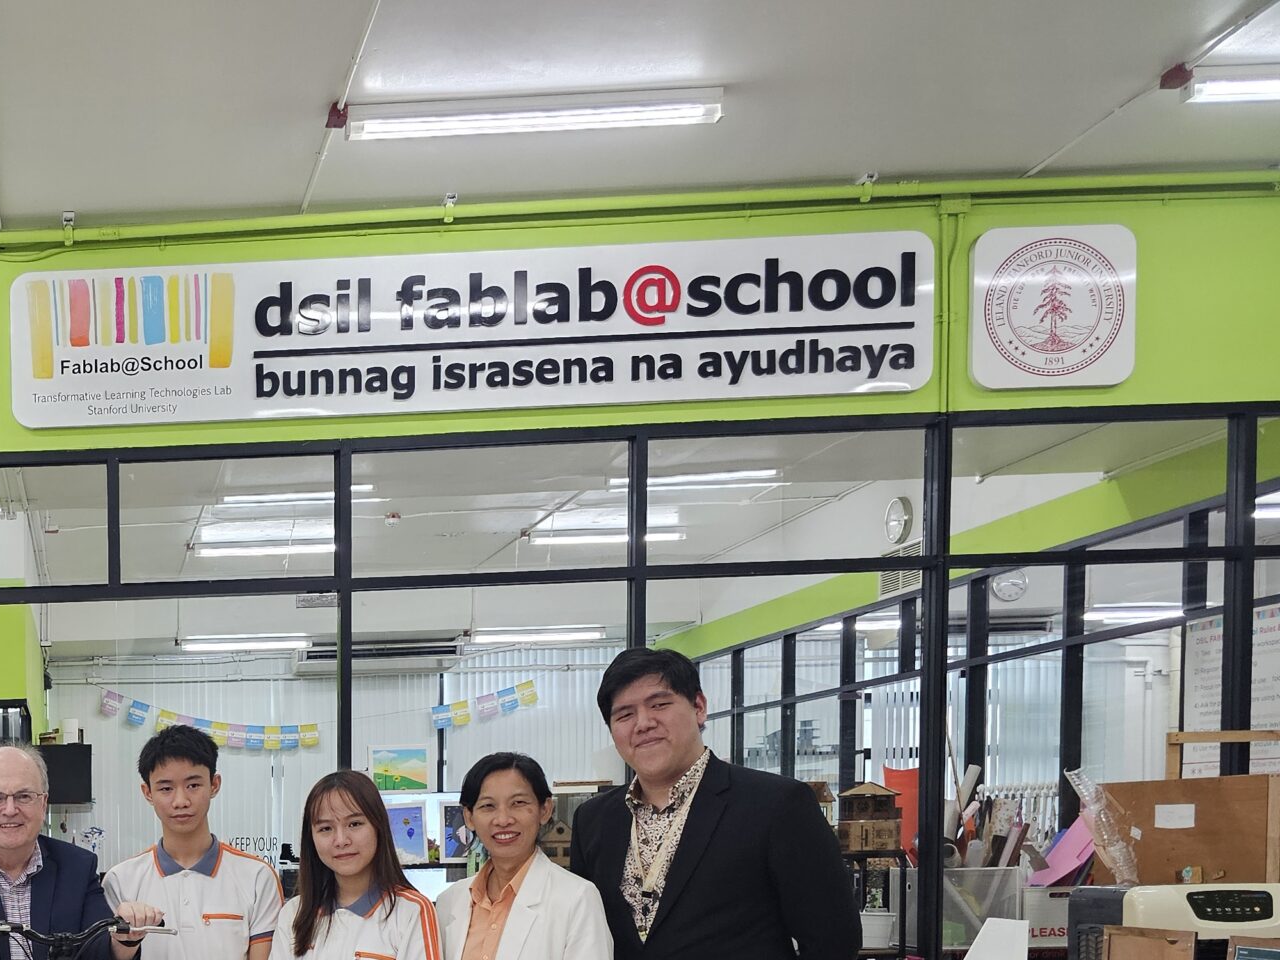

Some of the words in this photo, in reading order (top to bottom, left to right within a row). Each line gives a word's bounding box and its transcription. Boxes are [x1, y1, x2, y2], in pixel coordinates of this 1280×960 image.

[1005, 248, 1053, 281] TANFORD
[1054, 248, 1092, 268] JUNIOR
[254, 277, 371, 337] dsil
[395, 251, 916, 331] fablab@school
[60, 354, 203, 376] Fablab@School
[255, 363, 416, 400] bunnag
[432, 354, 614, 391] israsena
[630, 354, 683, 382] na
[697, 338, 915, 386] ayudhaya
[1044, 357, 1065, 366] 1891
[32, 391, 102, 404] Transformative
[104, 388, 146, 401] Learning
[149, 386, 212, 399] Technologies
[215, 385, 232, 396] Lab
[87, 404, 128, 416] Stanford
[130, 402, 178, 415] University
[252, 837, 278, 852] YOUR
[1029, 927, 1069, 938] LEAS
